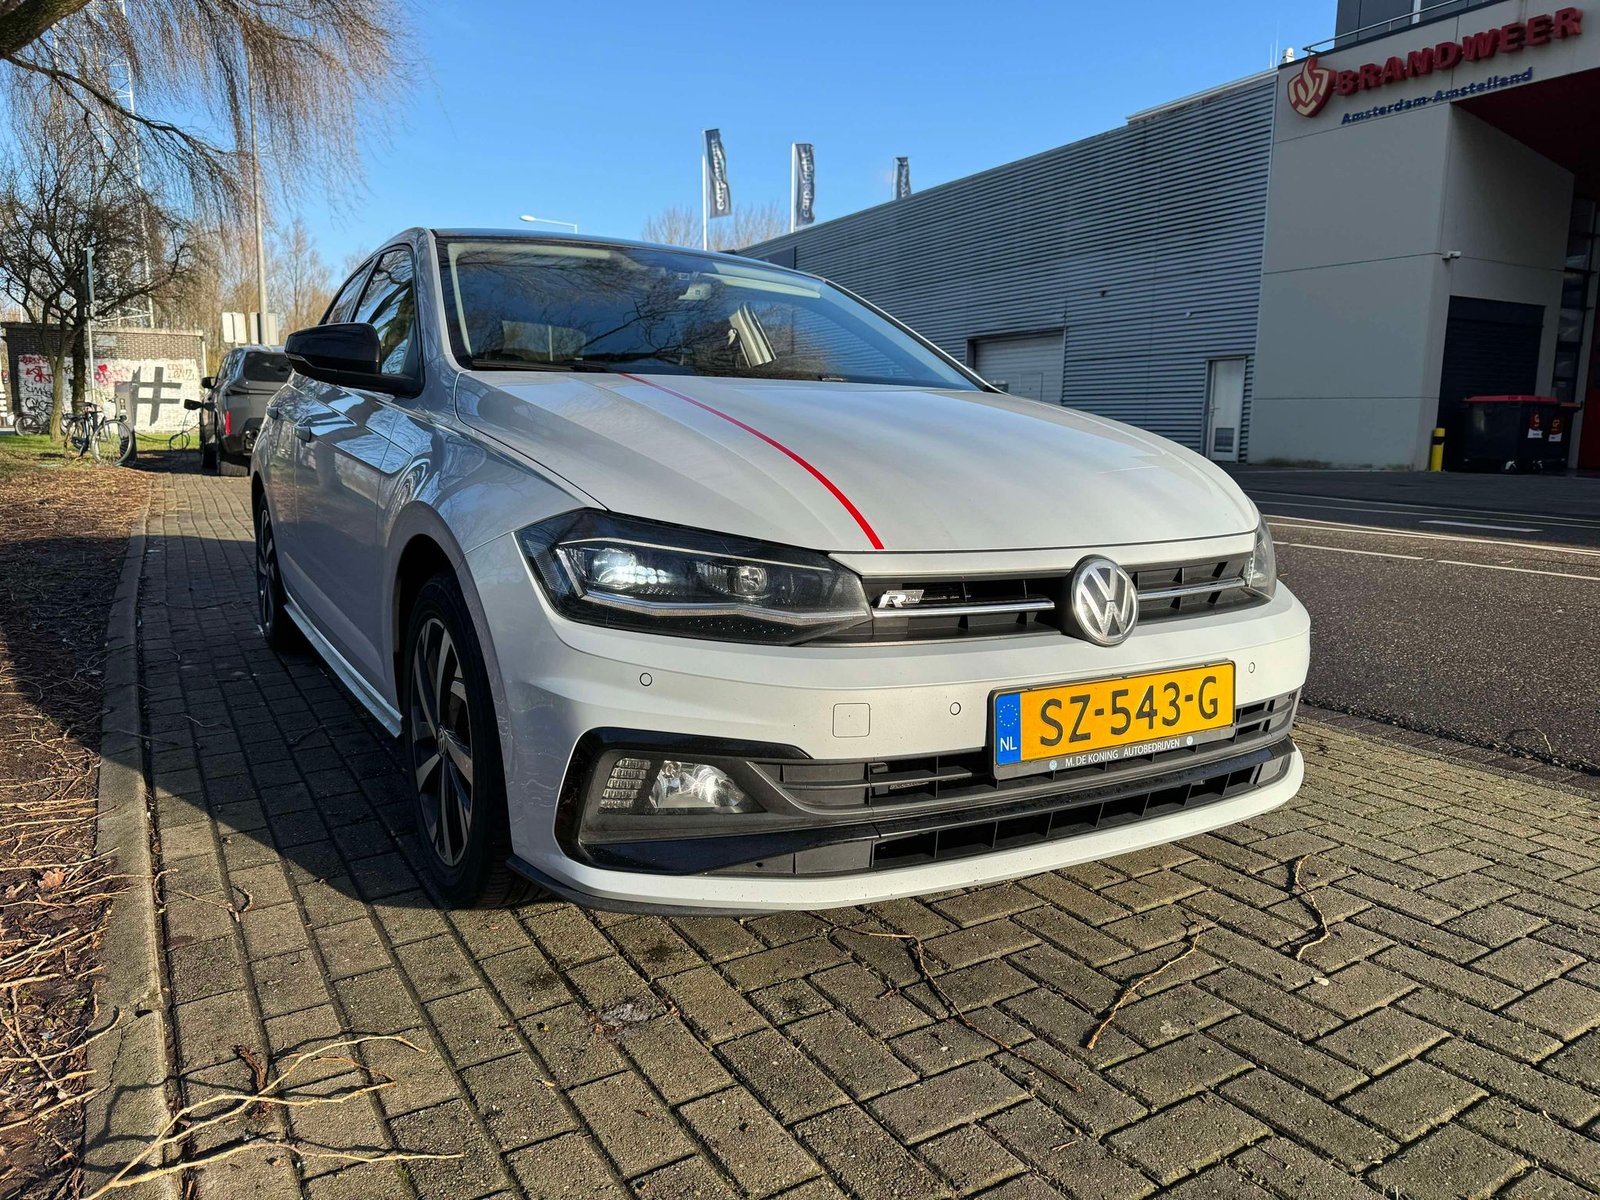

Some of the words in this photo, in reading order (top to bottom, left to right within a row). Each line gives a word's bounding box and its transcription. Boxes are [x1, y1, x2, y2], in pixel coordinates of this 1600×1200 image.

[1336, 7, 1583, 96] BRANDWEER
[1341, 66, 1533, 125] Amsterdam-Amstelland
[1040, 676, 1218, 747] SZ-543-G
[1000, 737, 1018, 752] NL
[1065, 758, 1075, 767] M.
[1076, 755, 1087, 764] DE
[1088, 749, 1119, 764] KONING
